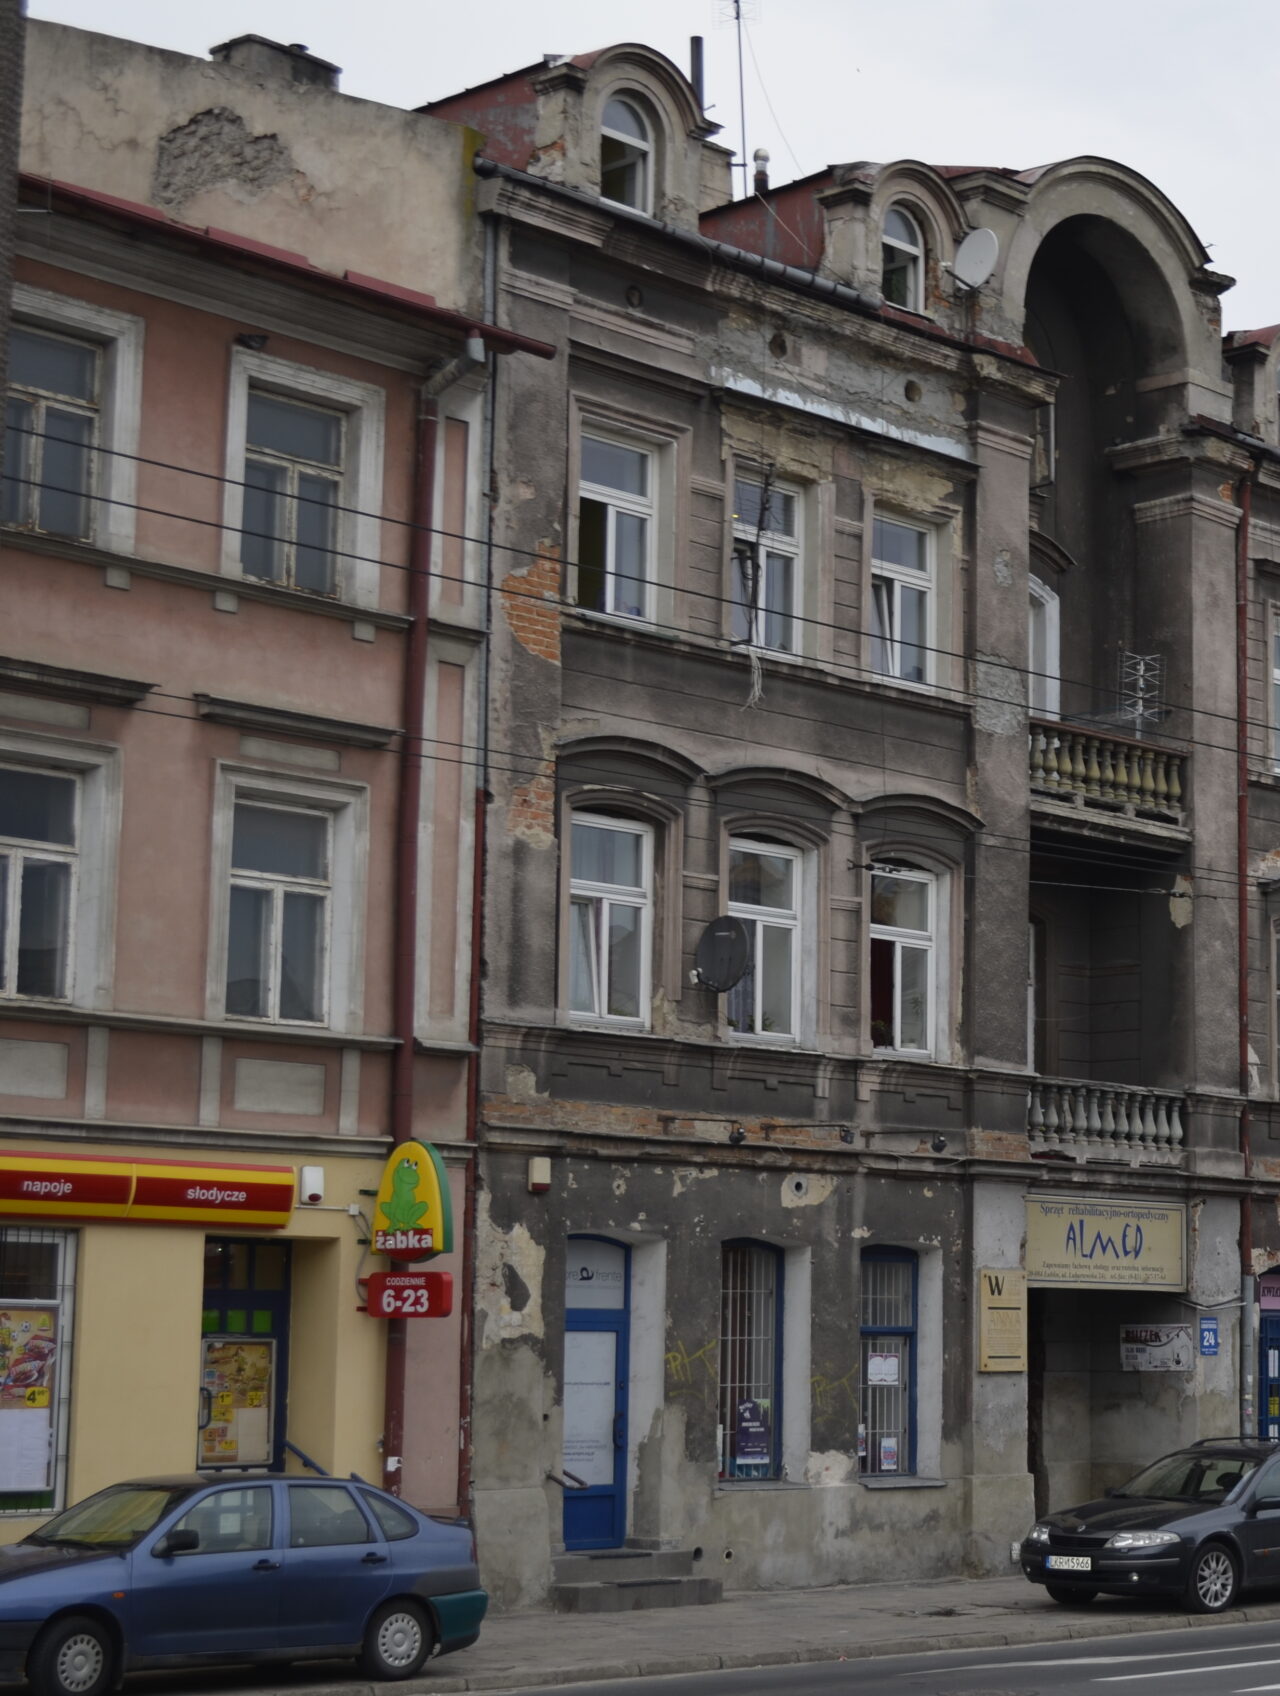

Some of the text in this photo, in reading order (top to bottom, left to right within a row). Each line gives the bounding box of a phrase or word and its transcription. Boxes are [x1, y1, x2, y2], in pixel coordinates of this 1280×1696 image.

[23, 1179, 73, 1196] napoje
[187, 1186, 247, 1204] słodycze
[1040, 1203, 1064, 1217] Sprzęt
[376, 1230, 433, 1249] żabka
[1066, 1219, 1143, 1260] ALMED
[386, 1277, 426, 1286] CODZIENNIE
[988, 1275, 1004, 1296] W
[382, 1289, 429, 1313] 6-23
[1203, 1331, 1215, 1346] 24
